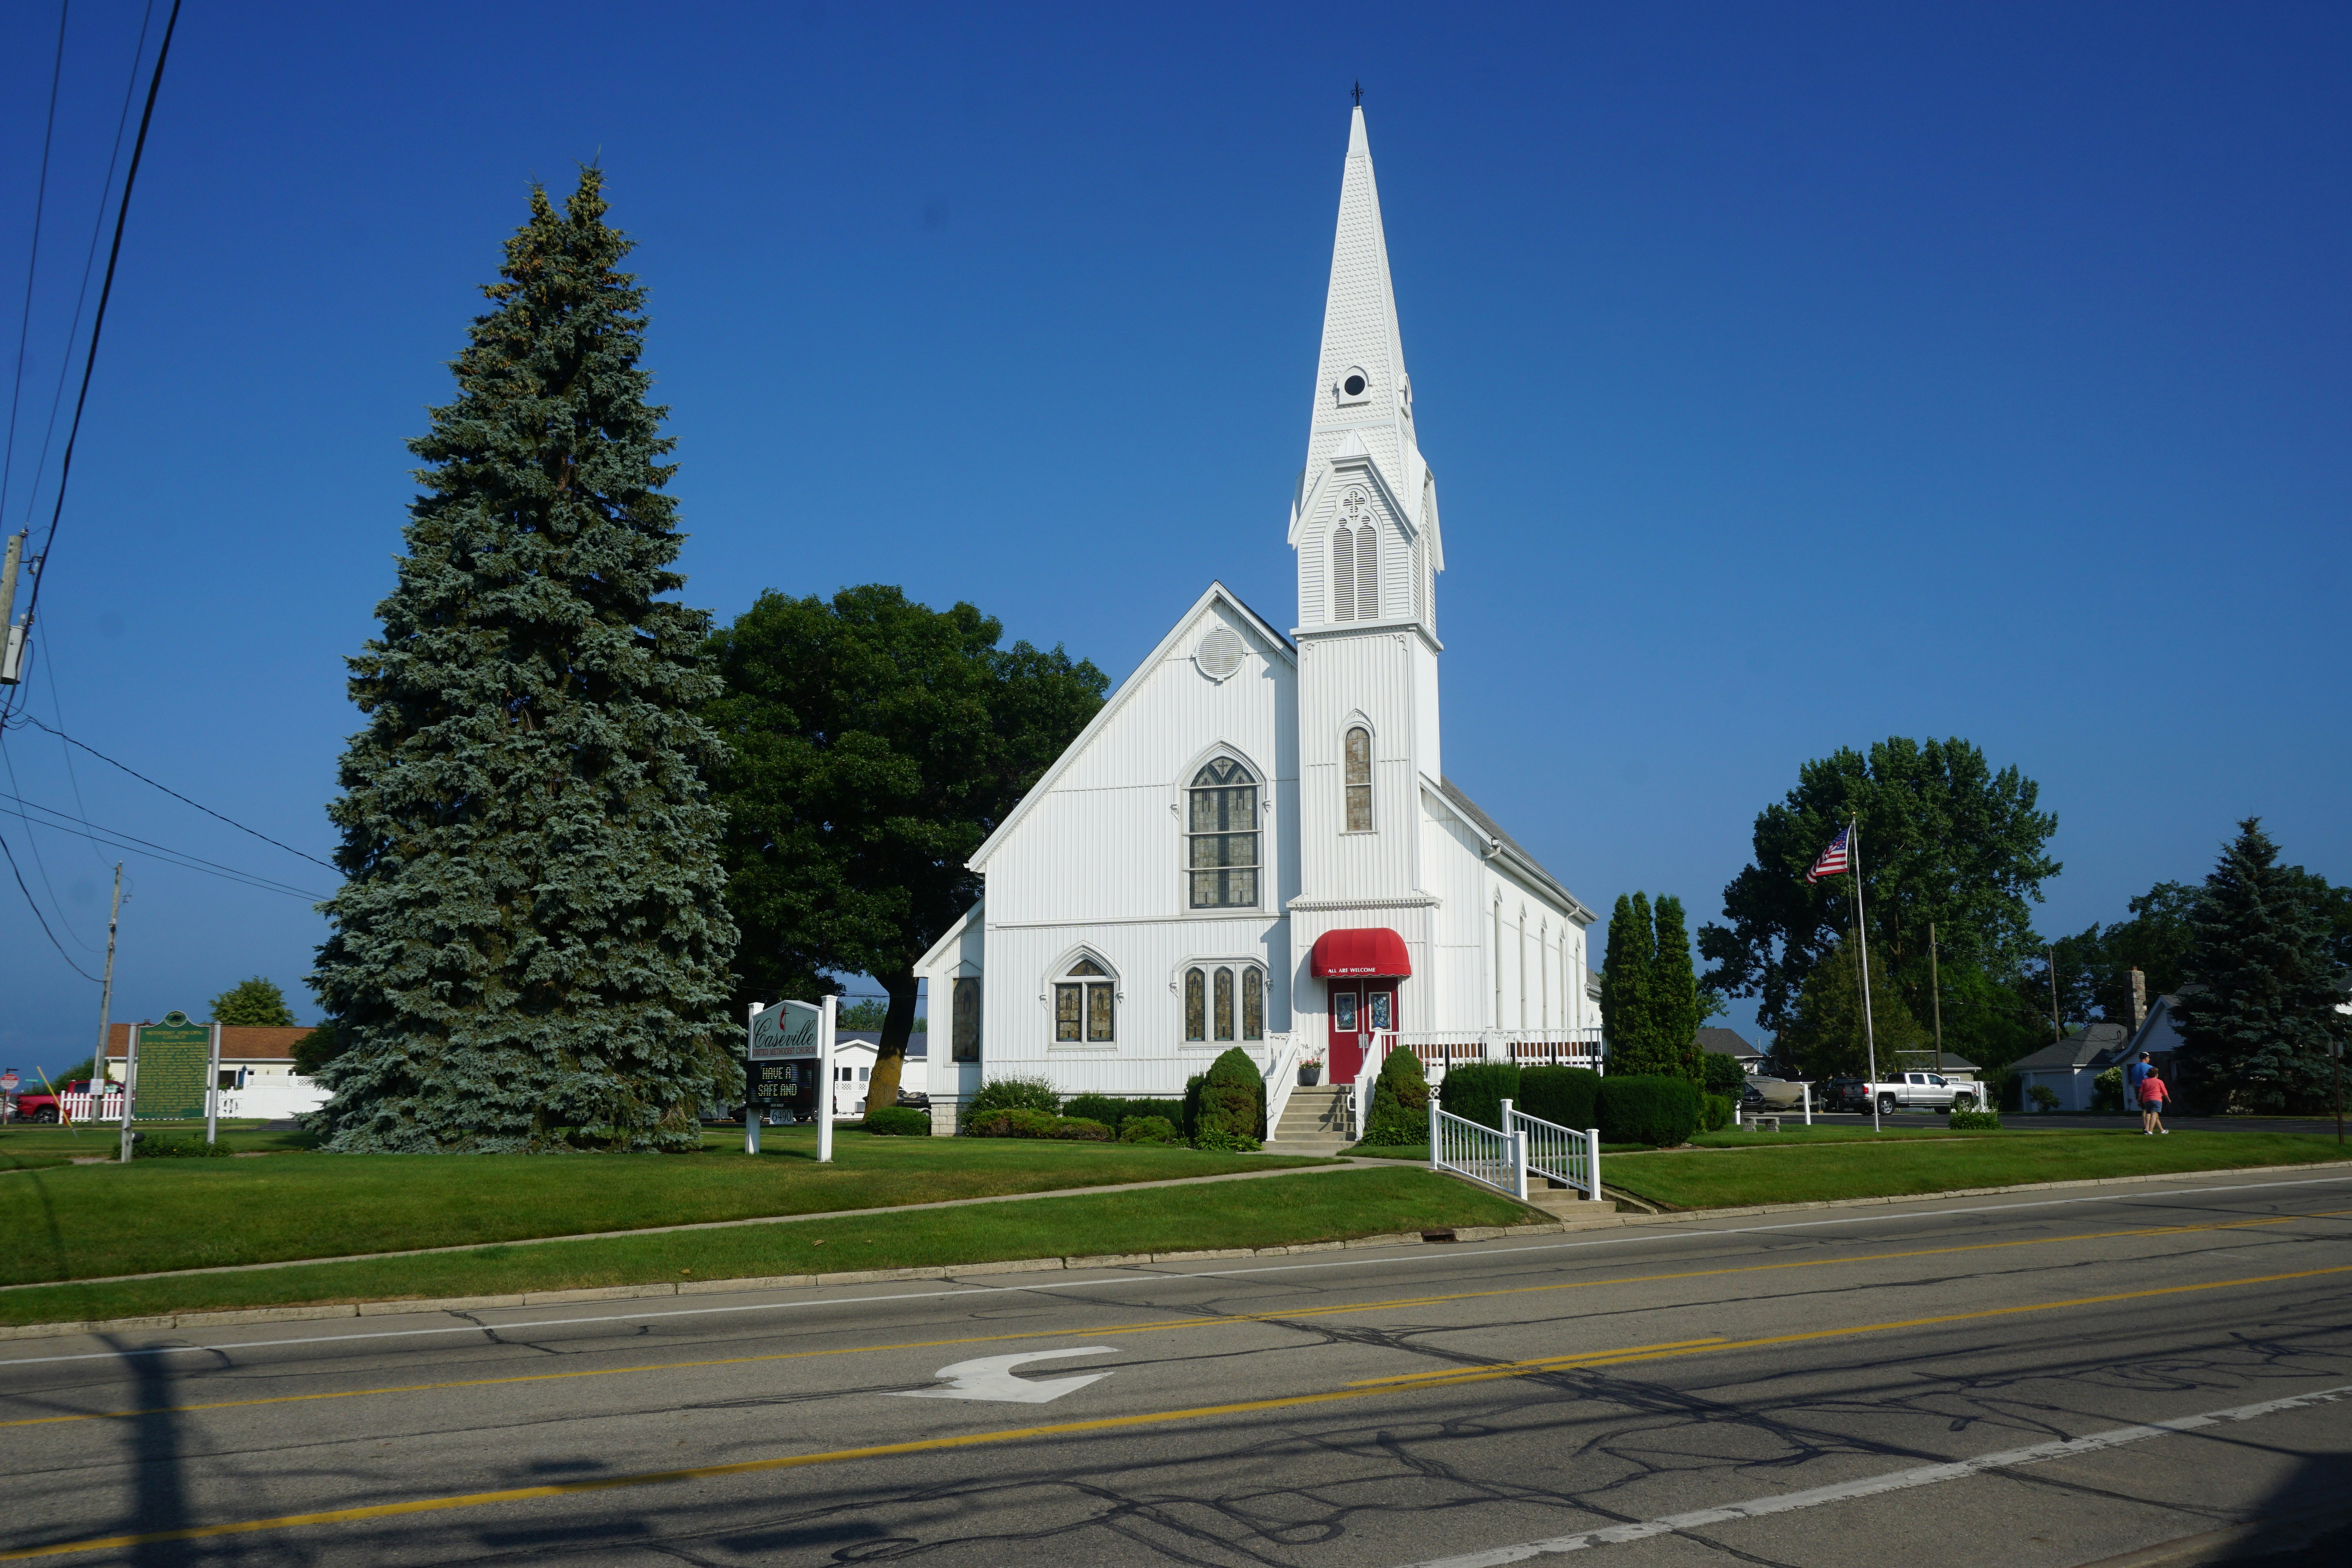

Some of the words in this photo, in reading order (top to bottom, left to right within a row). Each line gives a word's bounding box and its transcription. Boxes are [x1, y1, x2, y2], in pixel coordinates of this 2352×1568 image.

[754, 1018, 815, 1047] Caseville
[762, 1067, 783, 1079] HAVE
[785, 1067, 791, 1079] A
[758, 1084, 778, 1096] SAFE
[780, 1084, 797, 1096] AND
[772, 1111, 791, 1122] 6490
